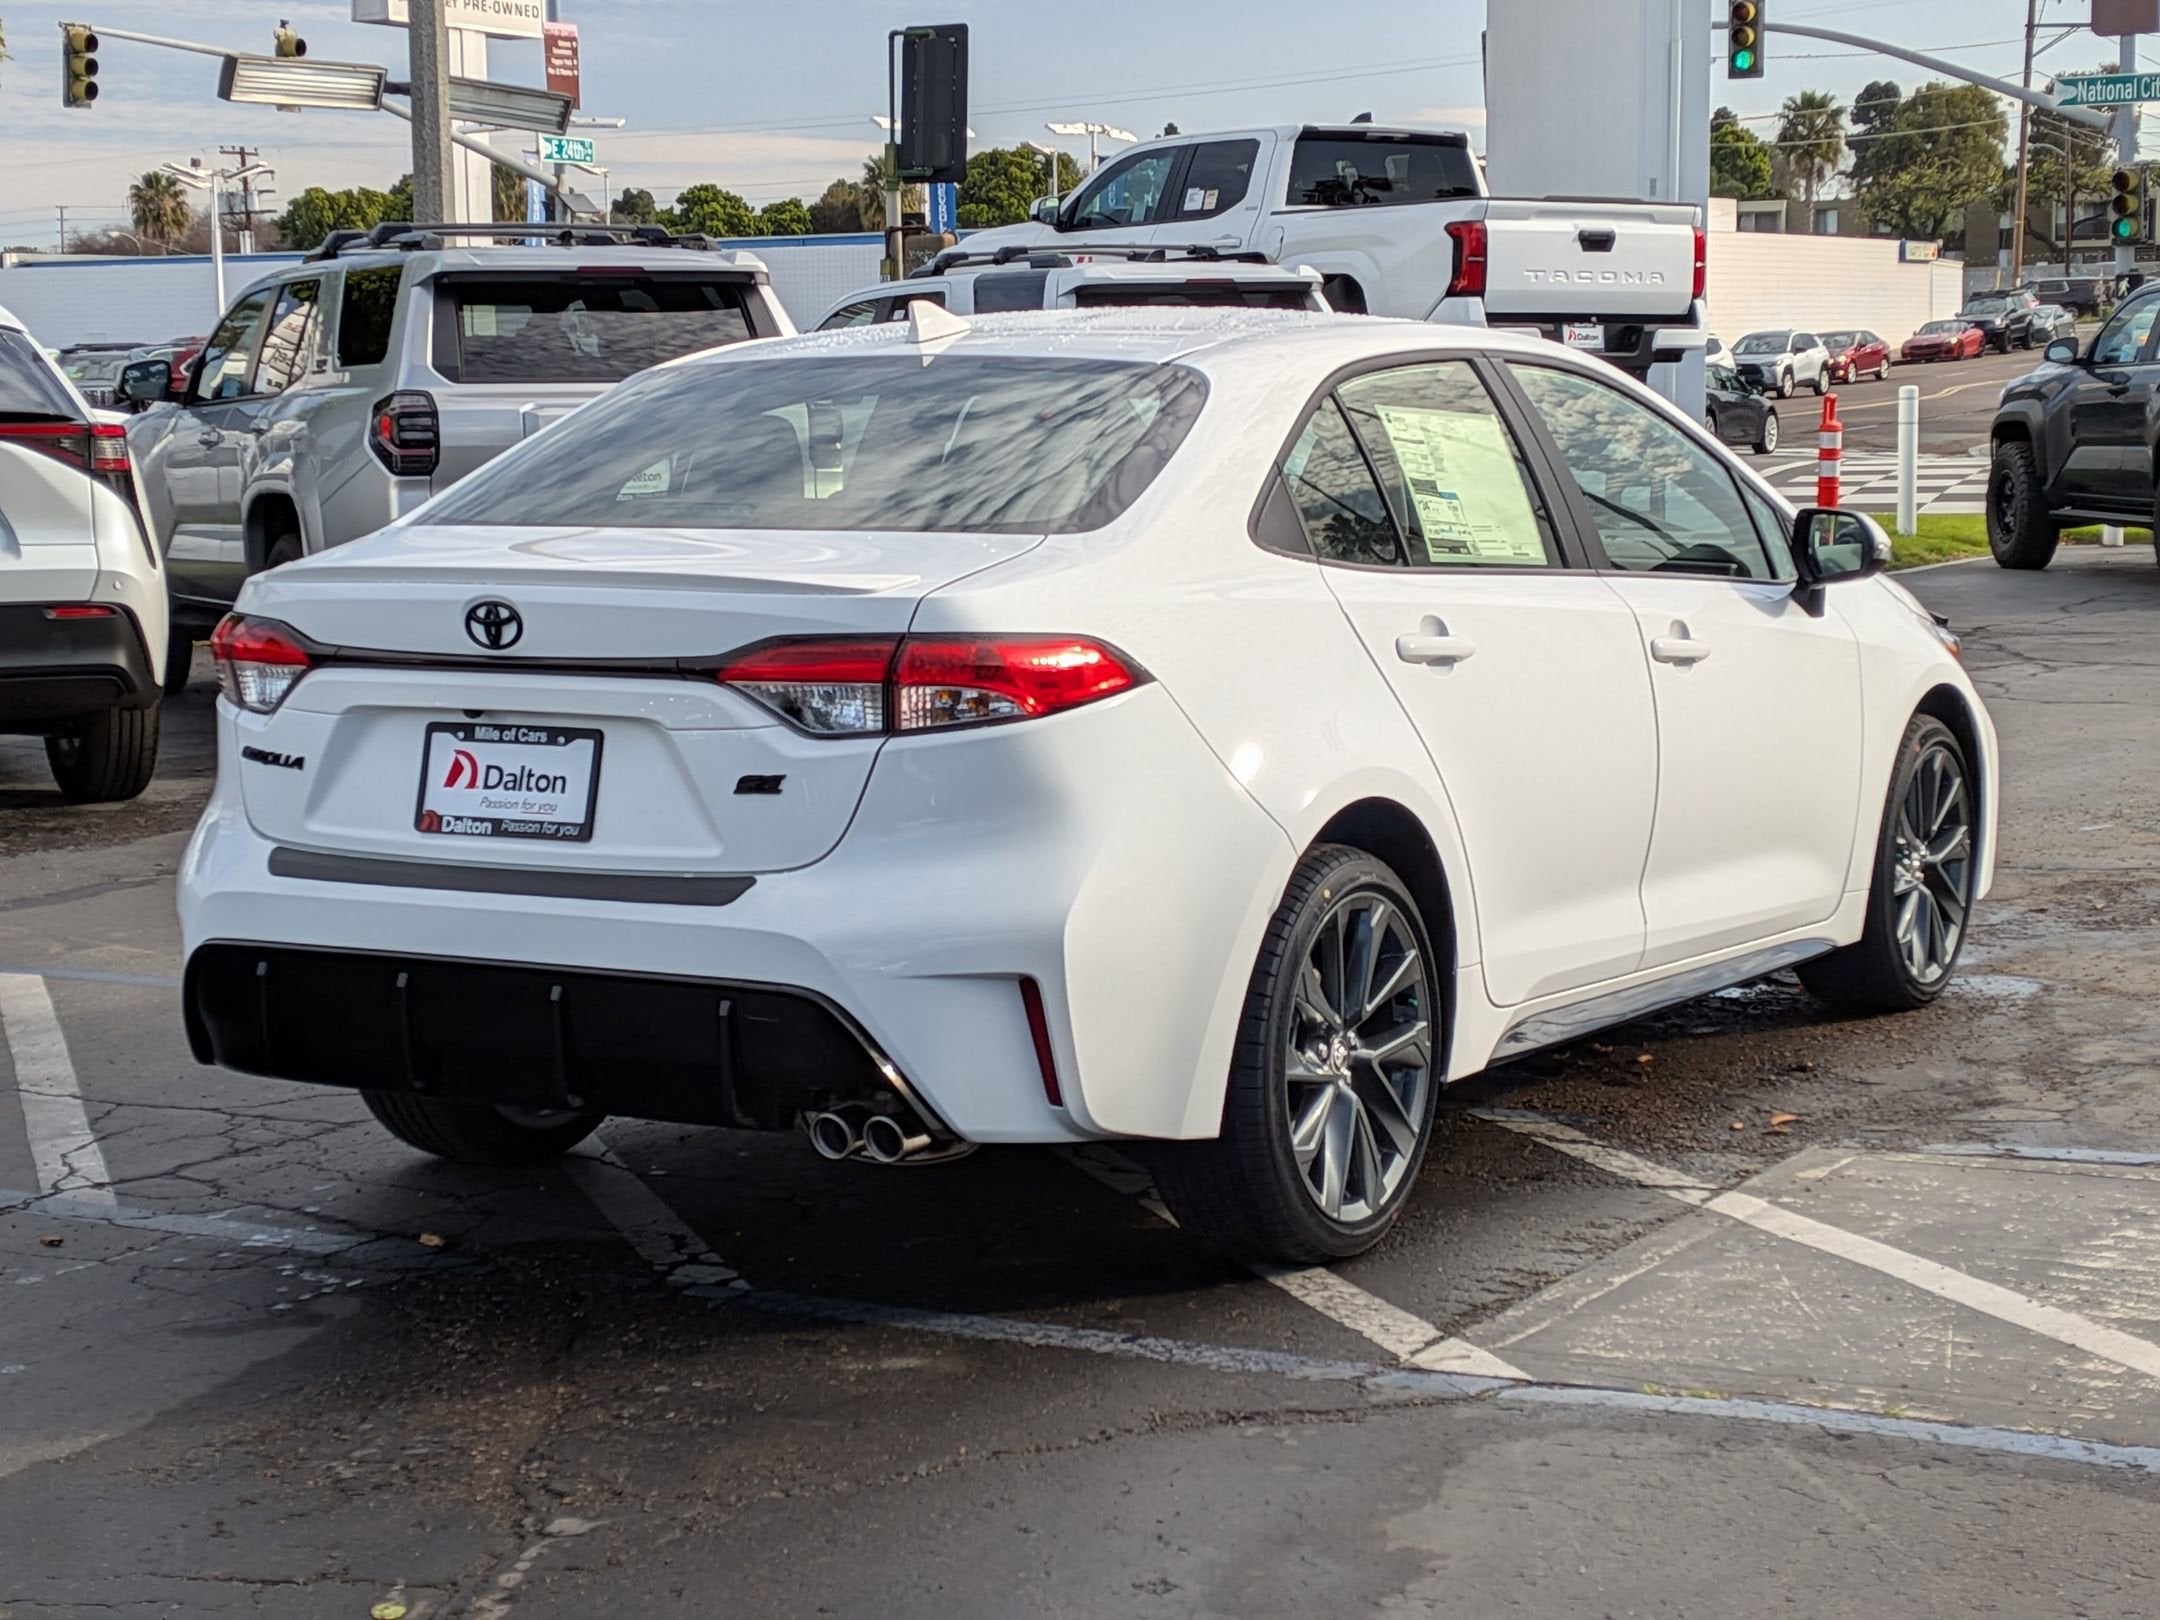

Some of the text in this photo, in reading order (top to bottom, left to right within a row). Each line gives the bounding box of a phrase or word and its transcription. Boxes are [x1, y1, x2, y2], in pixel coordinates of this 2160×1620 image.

[463, 0, 540, 19] PRE-OWNED
[2077, 77, 2138, 102] National
[551, 139, 561, 159] E
[561, 139, 585, 160] 24th
[1523, 269, 1665, 285] TACOMA
[474, 725, 548, 743] Mile of Cars
[481, 764, 567, 794] Dalton
[479, 796, 558, 814] Passion for you
[441, 815, 580, 838] Dalton Passion for you
